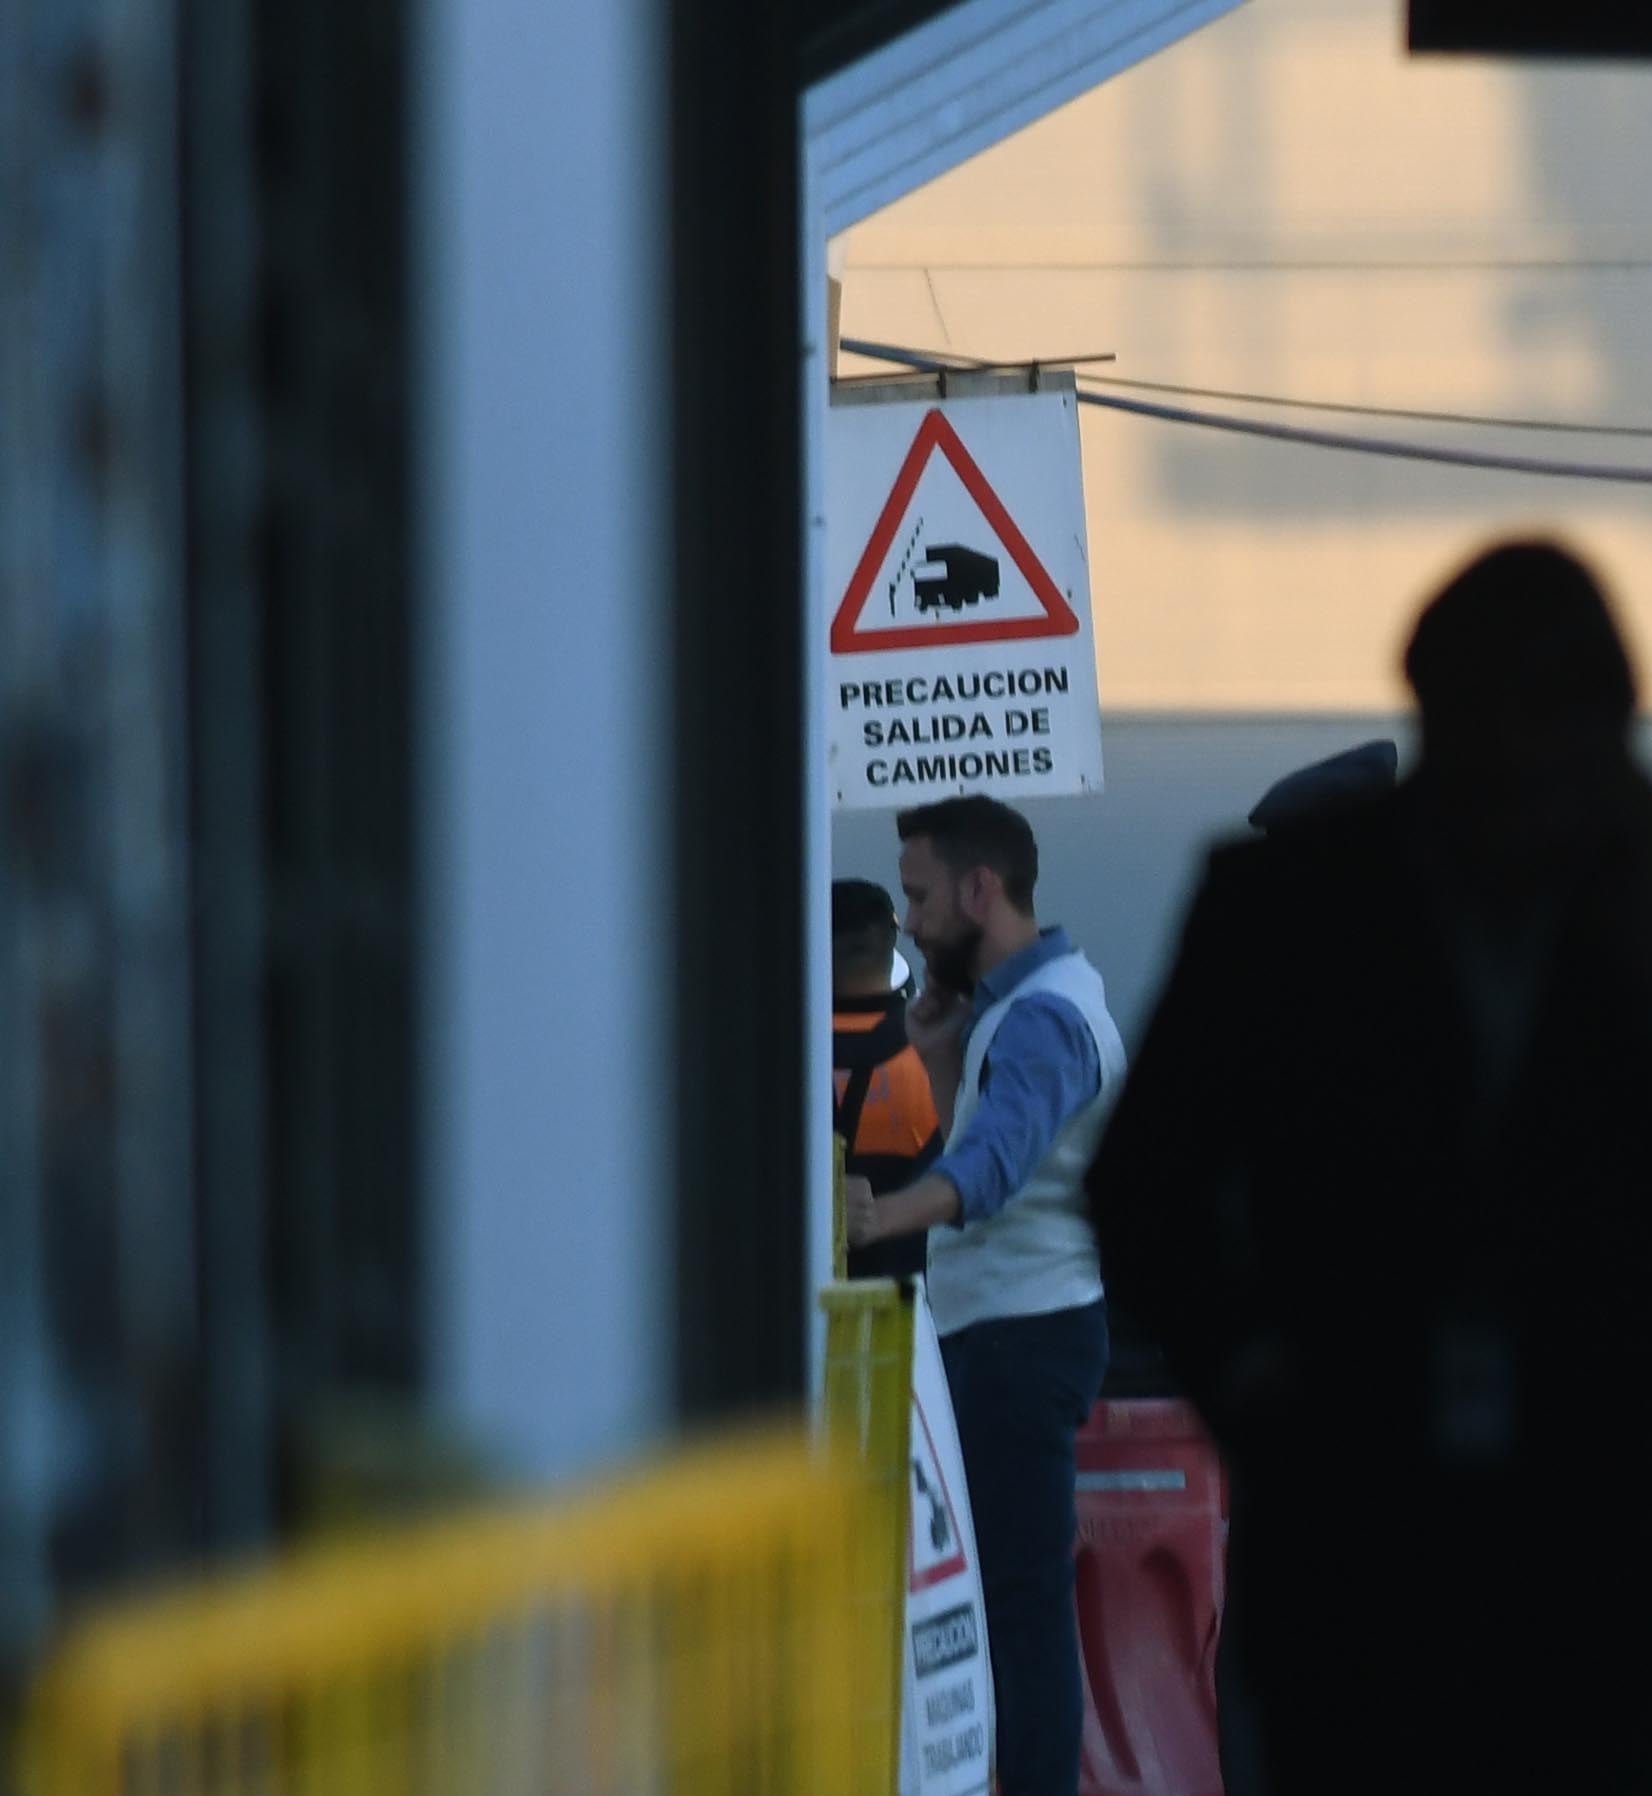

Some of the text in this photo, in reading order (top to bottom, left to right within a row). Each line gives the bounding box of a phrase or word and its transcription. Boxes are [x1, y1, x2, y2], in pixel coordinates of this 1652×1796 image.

[839, 666, 1069, 710] PRECAUCION
[863, 707, 1050, 747] SALIDA DE
[866, 747, 1053, 786] CAMIONES
